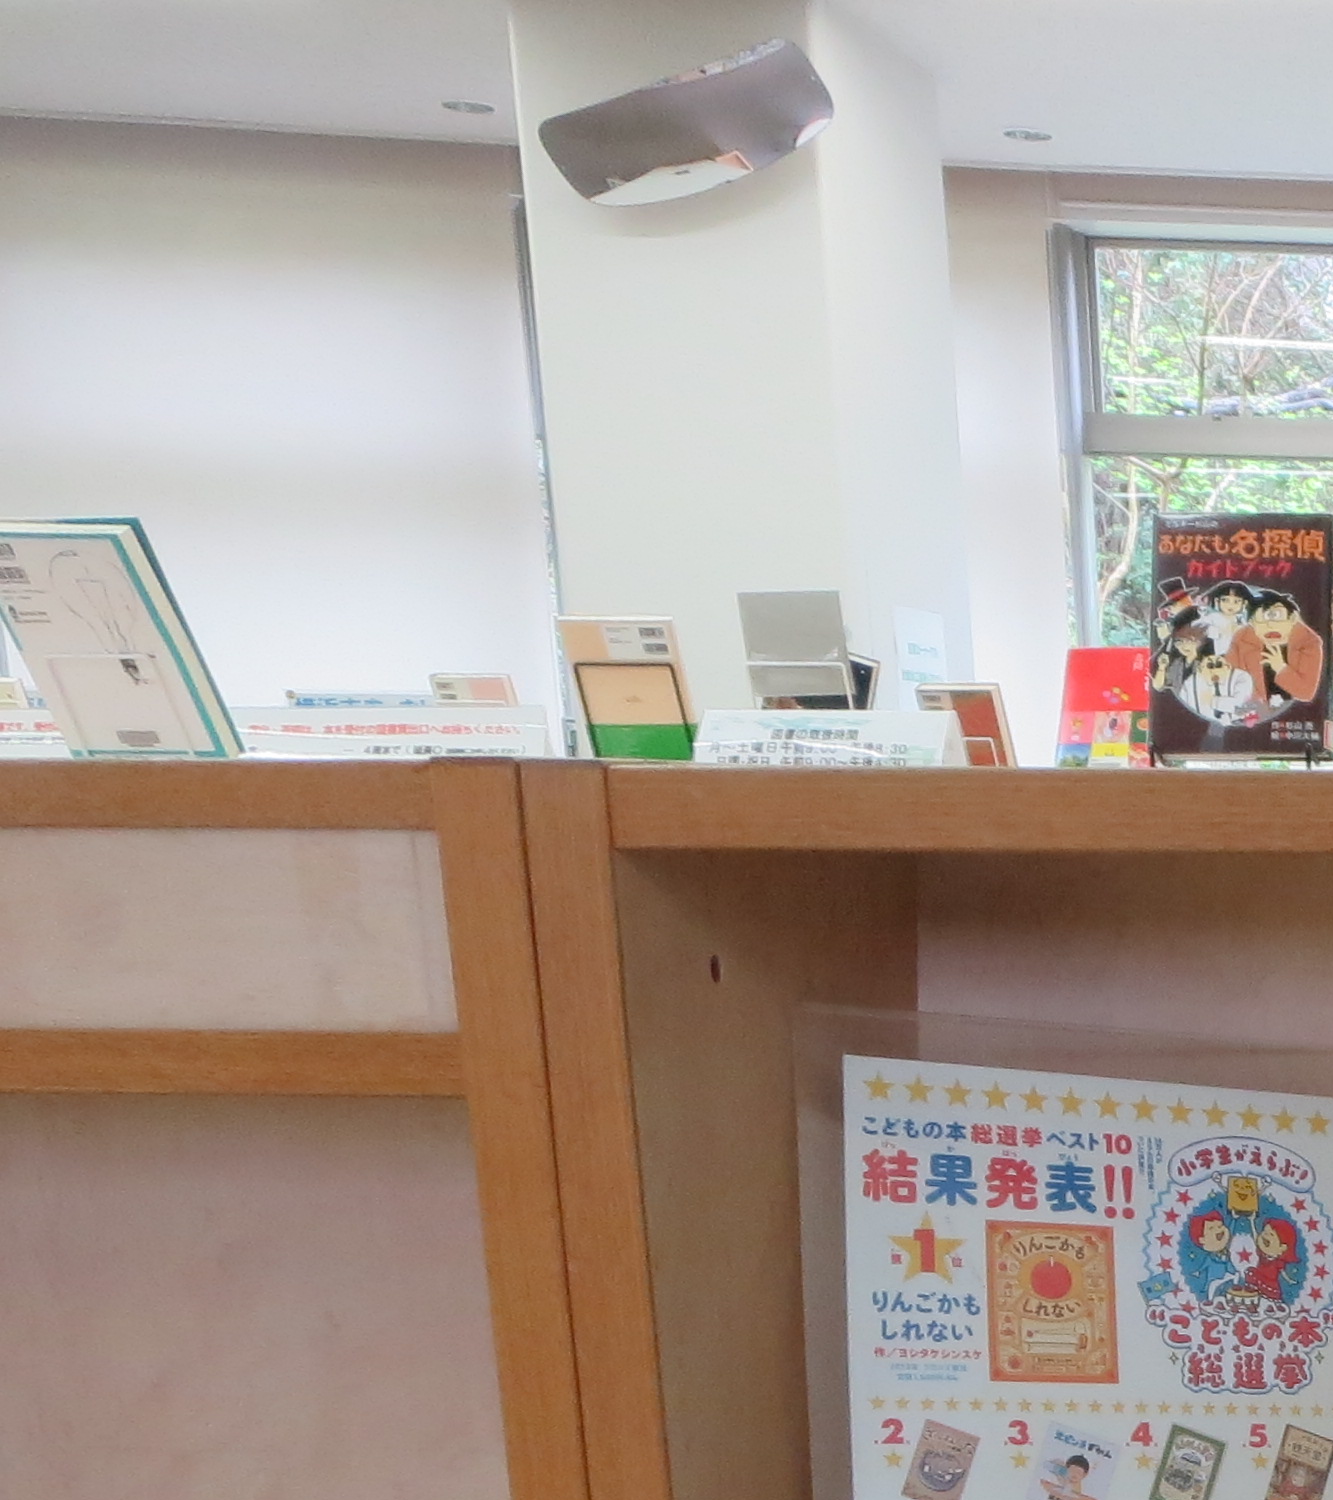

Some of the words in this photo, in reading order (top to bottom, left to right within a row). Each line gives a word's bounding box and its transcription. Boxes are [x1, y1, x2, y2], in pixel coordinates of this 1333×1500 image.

[1158, 529, 1326, 561] あなたも名探偵
[1012, 1235, 1089, 1260] りんごかも
[872, 1290, 981, 1316] りんごかも
[1021, 1299, 1082, 1318] しれない
[881, 1319, 974, 1342] しれない
[1186, 1352, 1309, 1390] 総選挙
